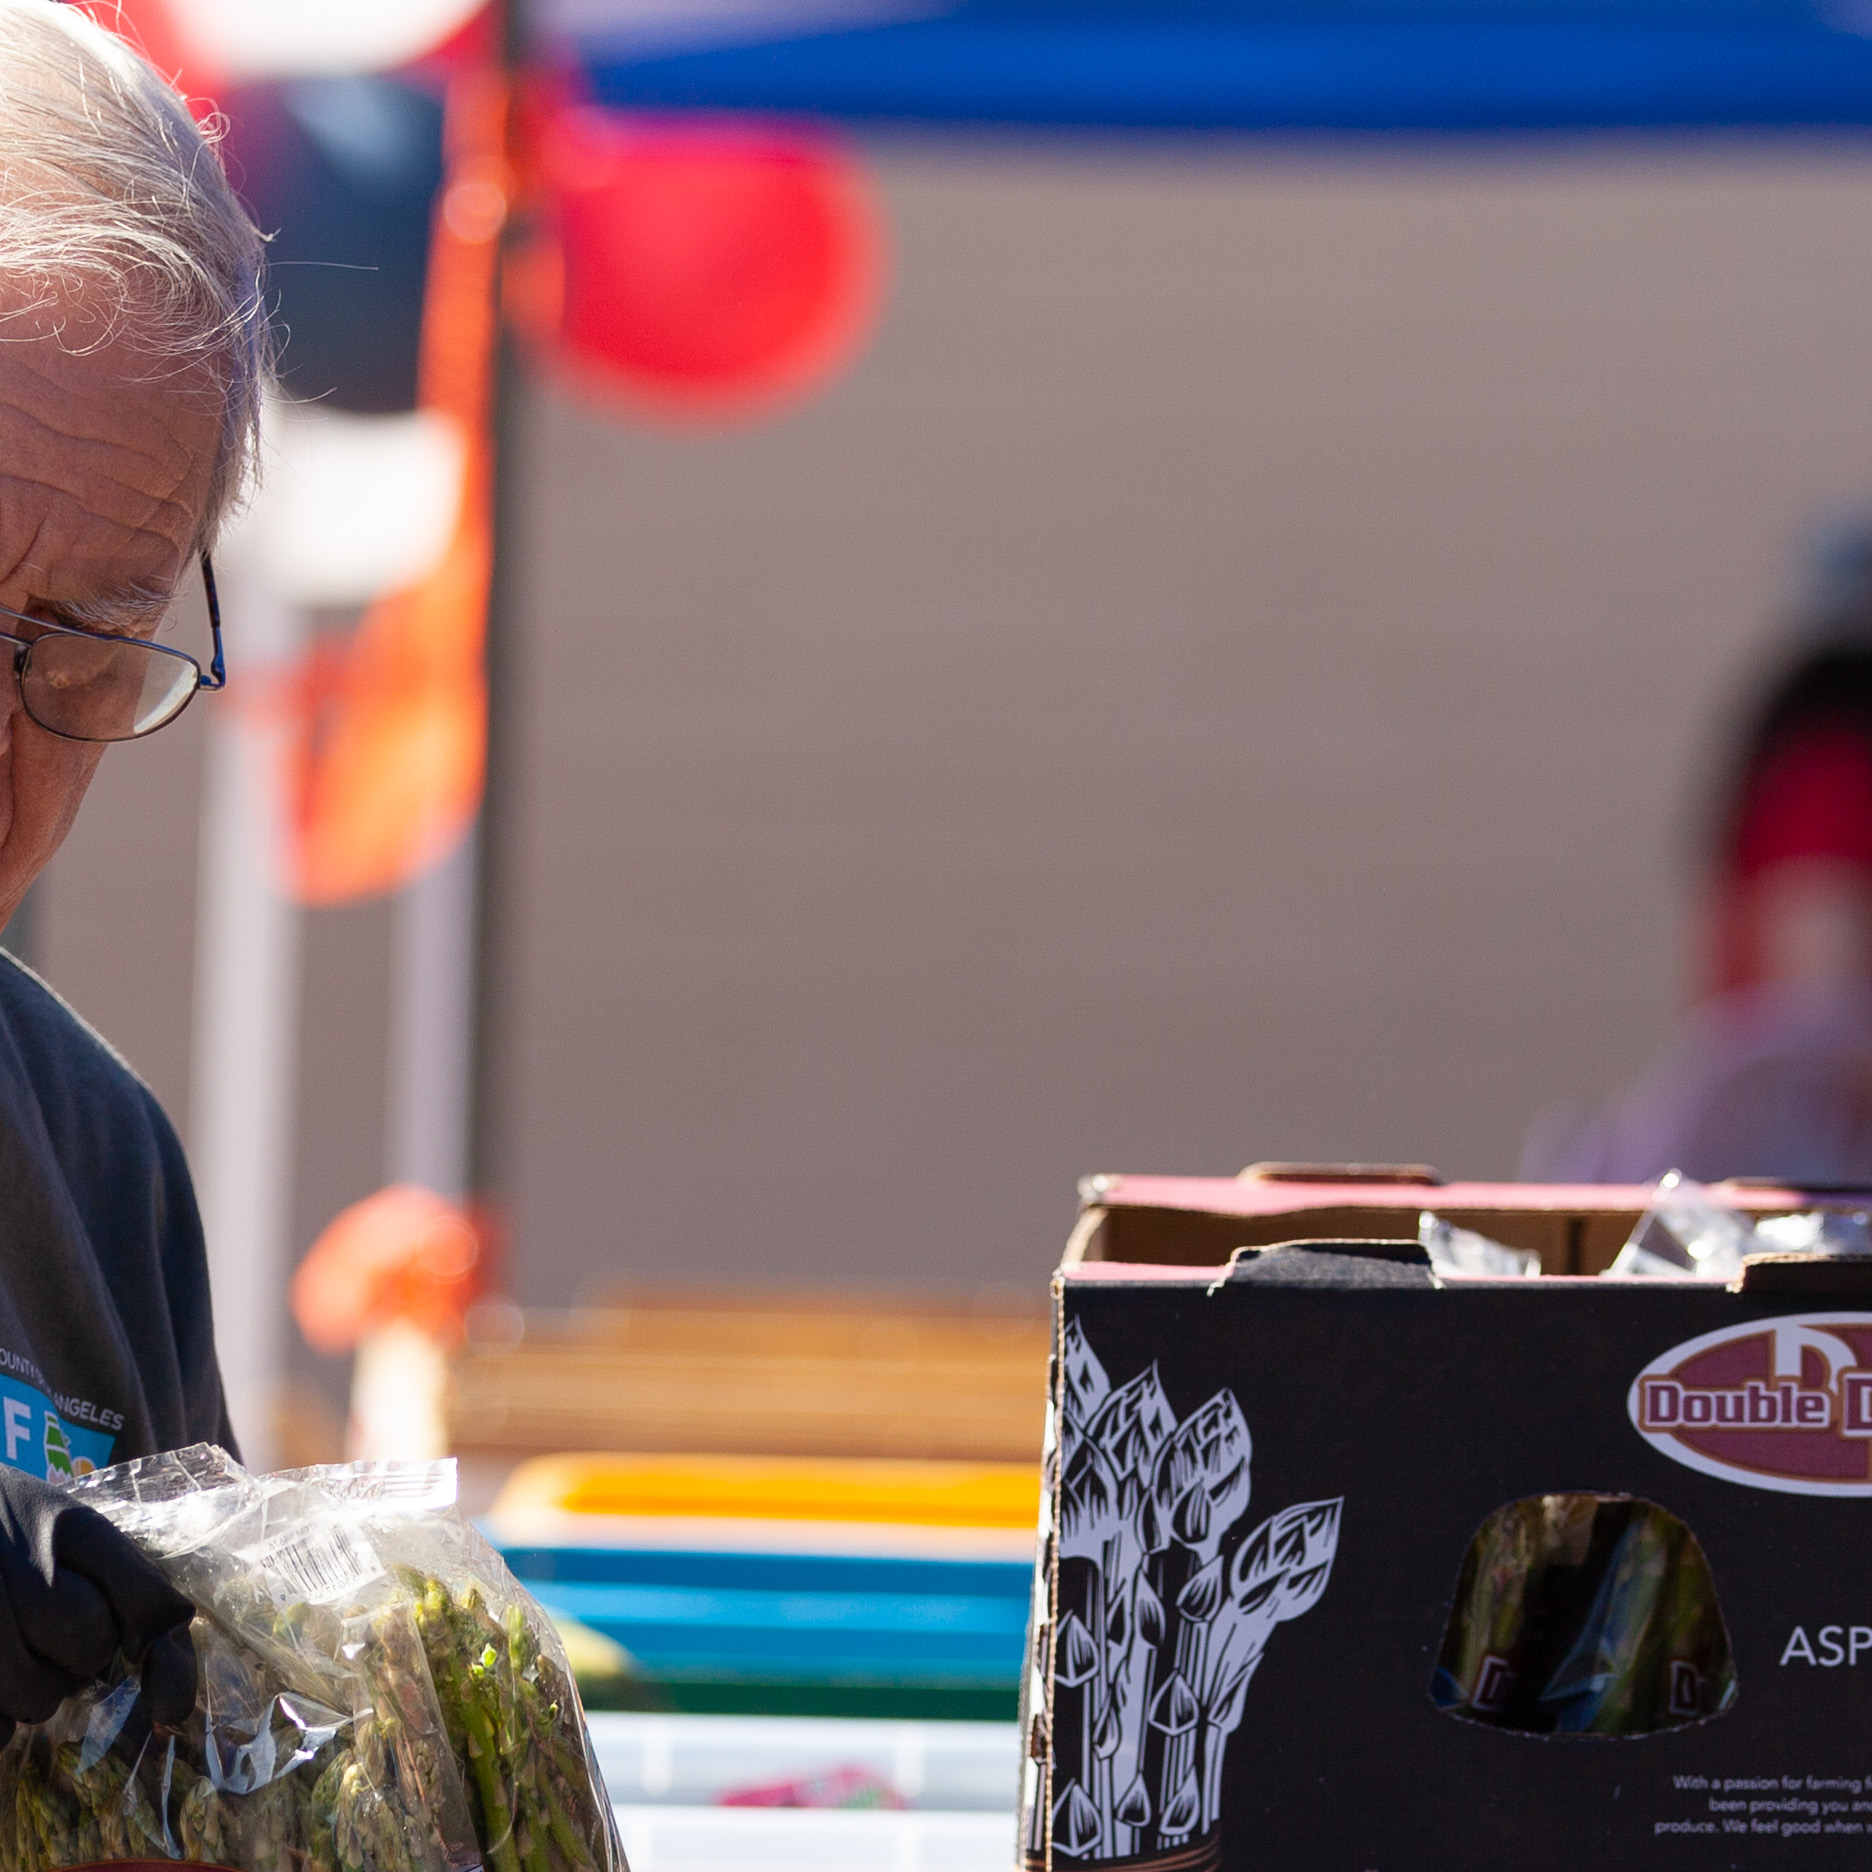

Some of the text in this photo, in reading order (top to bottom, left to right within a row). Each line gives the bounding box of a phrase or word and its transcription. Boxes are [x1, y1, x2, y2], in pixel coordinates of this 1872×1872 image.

[1644, 1381, 1828, 1427] Double
[1672, 1775, 1708, 1789] With
[1711, 1778, 1721, 1789] a
[1723, 1776, 1778, 1792] passion
[1781, 1774, 1803, 1789] for
[1806, 1774, 1862, 1794] farming
[1708, 1797, 1747, 1812] been
[1749, 1797, 1818, 1815] providing
[1821, 1801, 1849, 1815] you
[1722, 1818, 1748, 1833] We
[1750, 1818, 1779, 1833] feel
[1781, 1818, 1821, 1837] good
[1824, 1819, 1863, 1833] when
